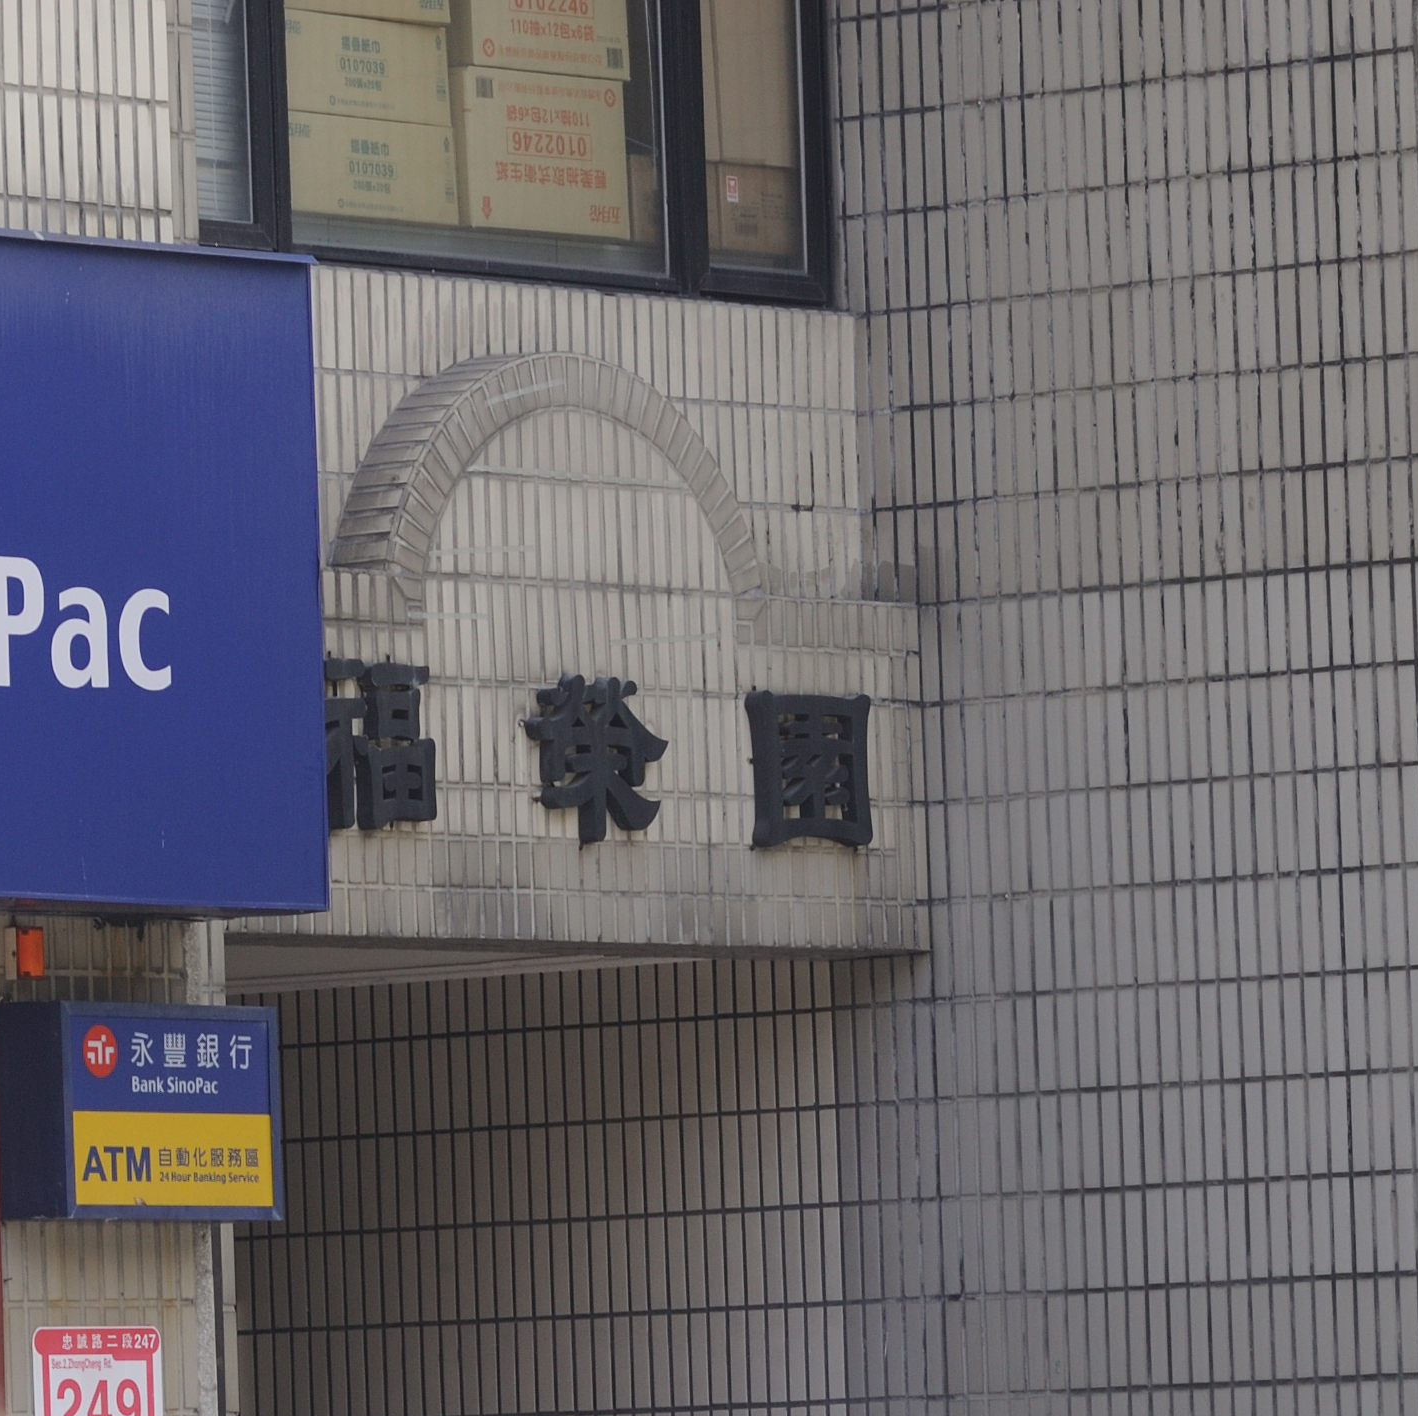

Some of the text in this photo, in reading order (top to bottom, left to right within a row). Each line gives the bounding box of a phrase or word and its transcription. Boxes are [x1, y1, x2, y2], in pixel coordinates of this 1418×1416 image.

[339, 57, 385, 75] 0107039
[131, 1031, 252, 1070] 永豐銀行
[131, 1075, 218, 1095] Bank SinoPac
[82, 1145, 152, 1183] ATM
[158, 1146, 260, 1168] 自動化服務區
[159, 1171, 260, 1185] 24 Hour Banking Service
